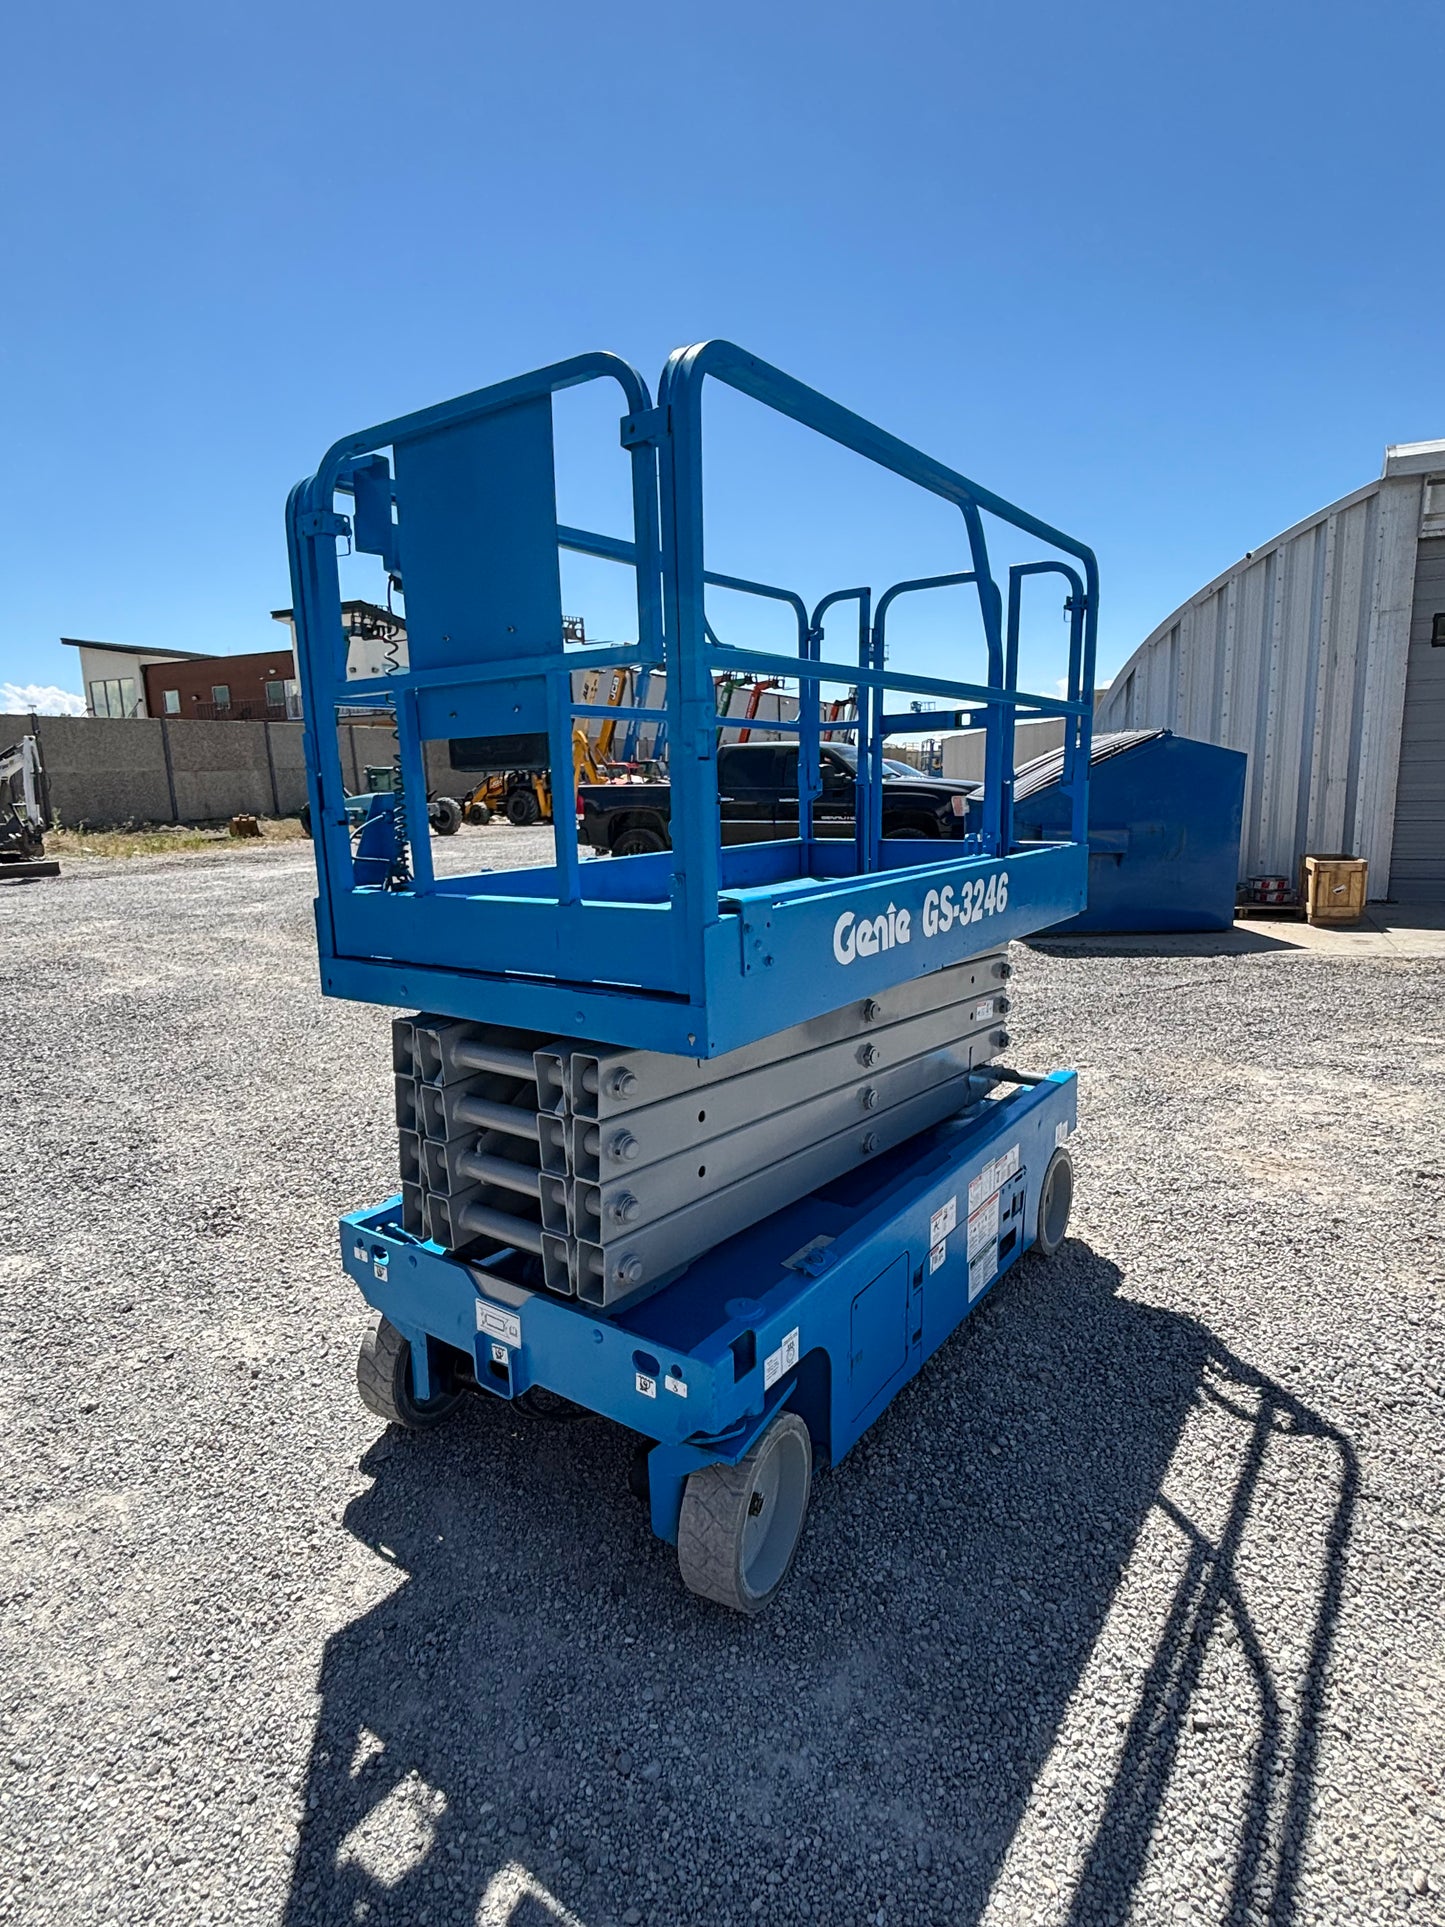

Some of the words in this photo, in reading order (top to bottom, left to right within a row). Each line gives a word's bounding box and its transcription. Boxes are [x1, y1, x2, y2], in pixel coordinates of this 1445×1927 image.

[609, 676, 620, 700] JCB
[833, 901, 911, 965] Genie
[922, 872, 1009, 938] GS-3246
